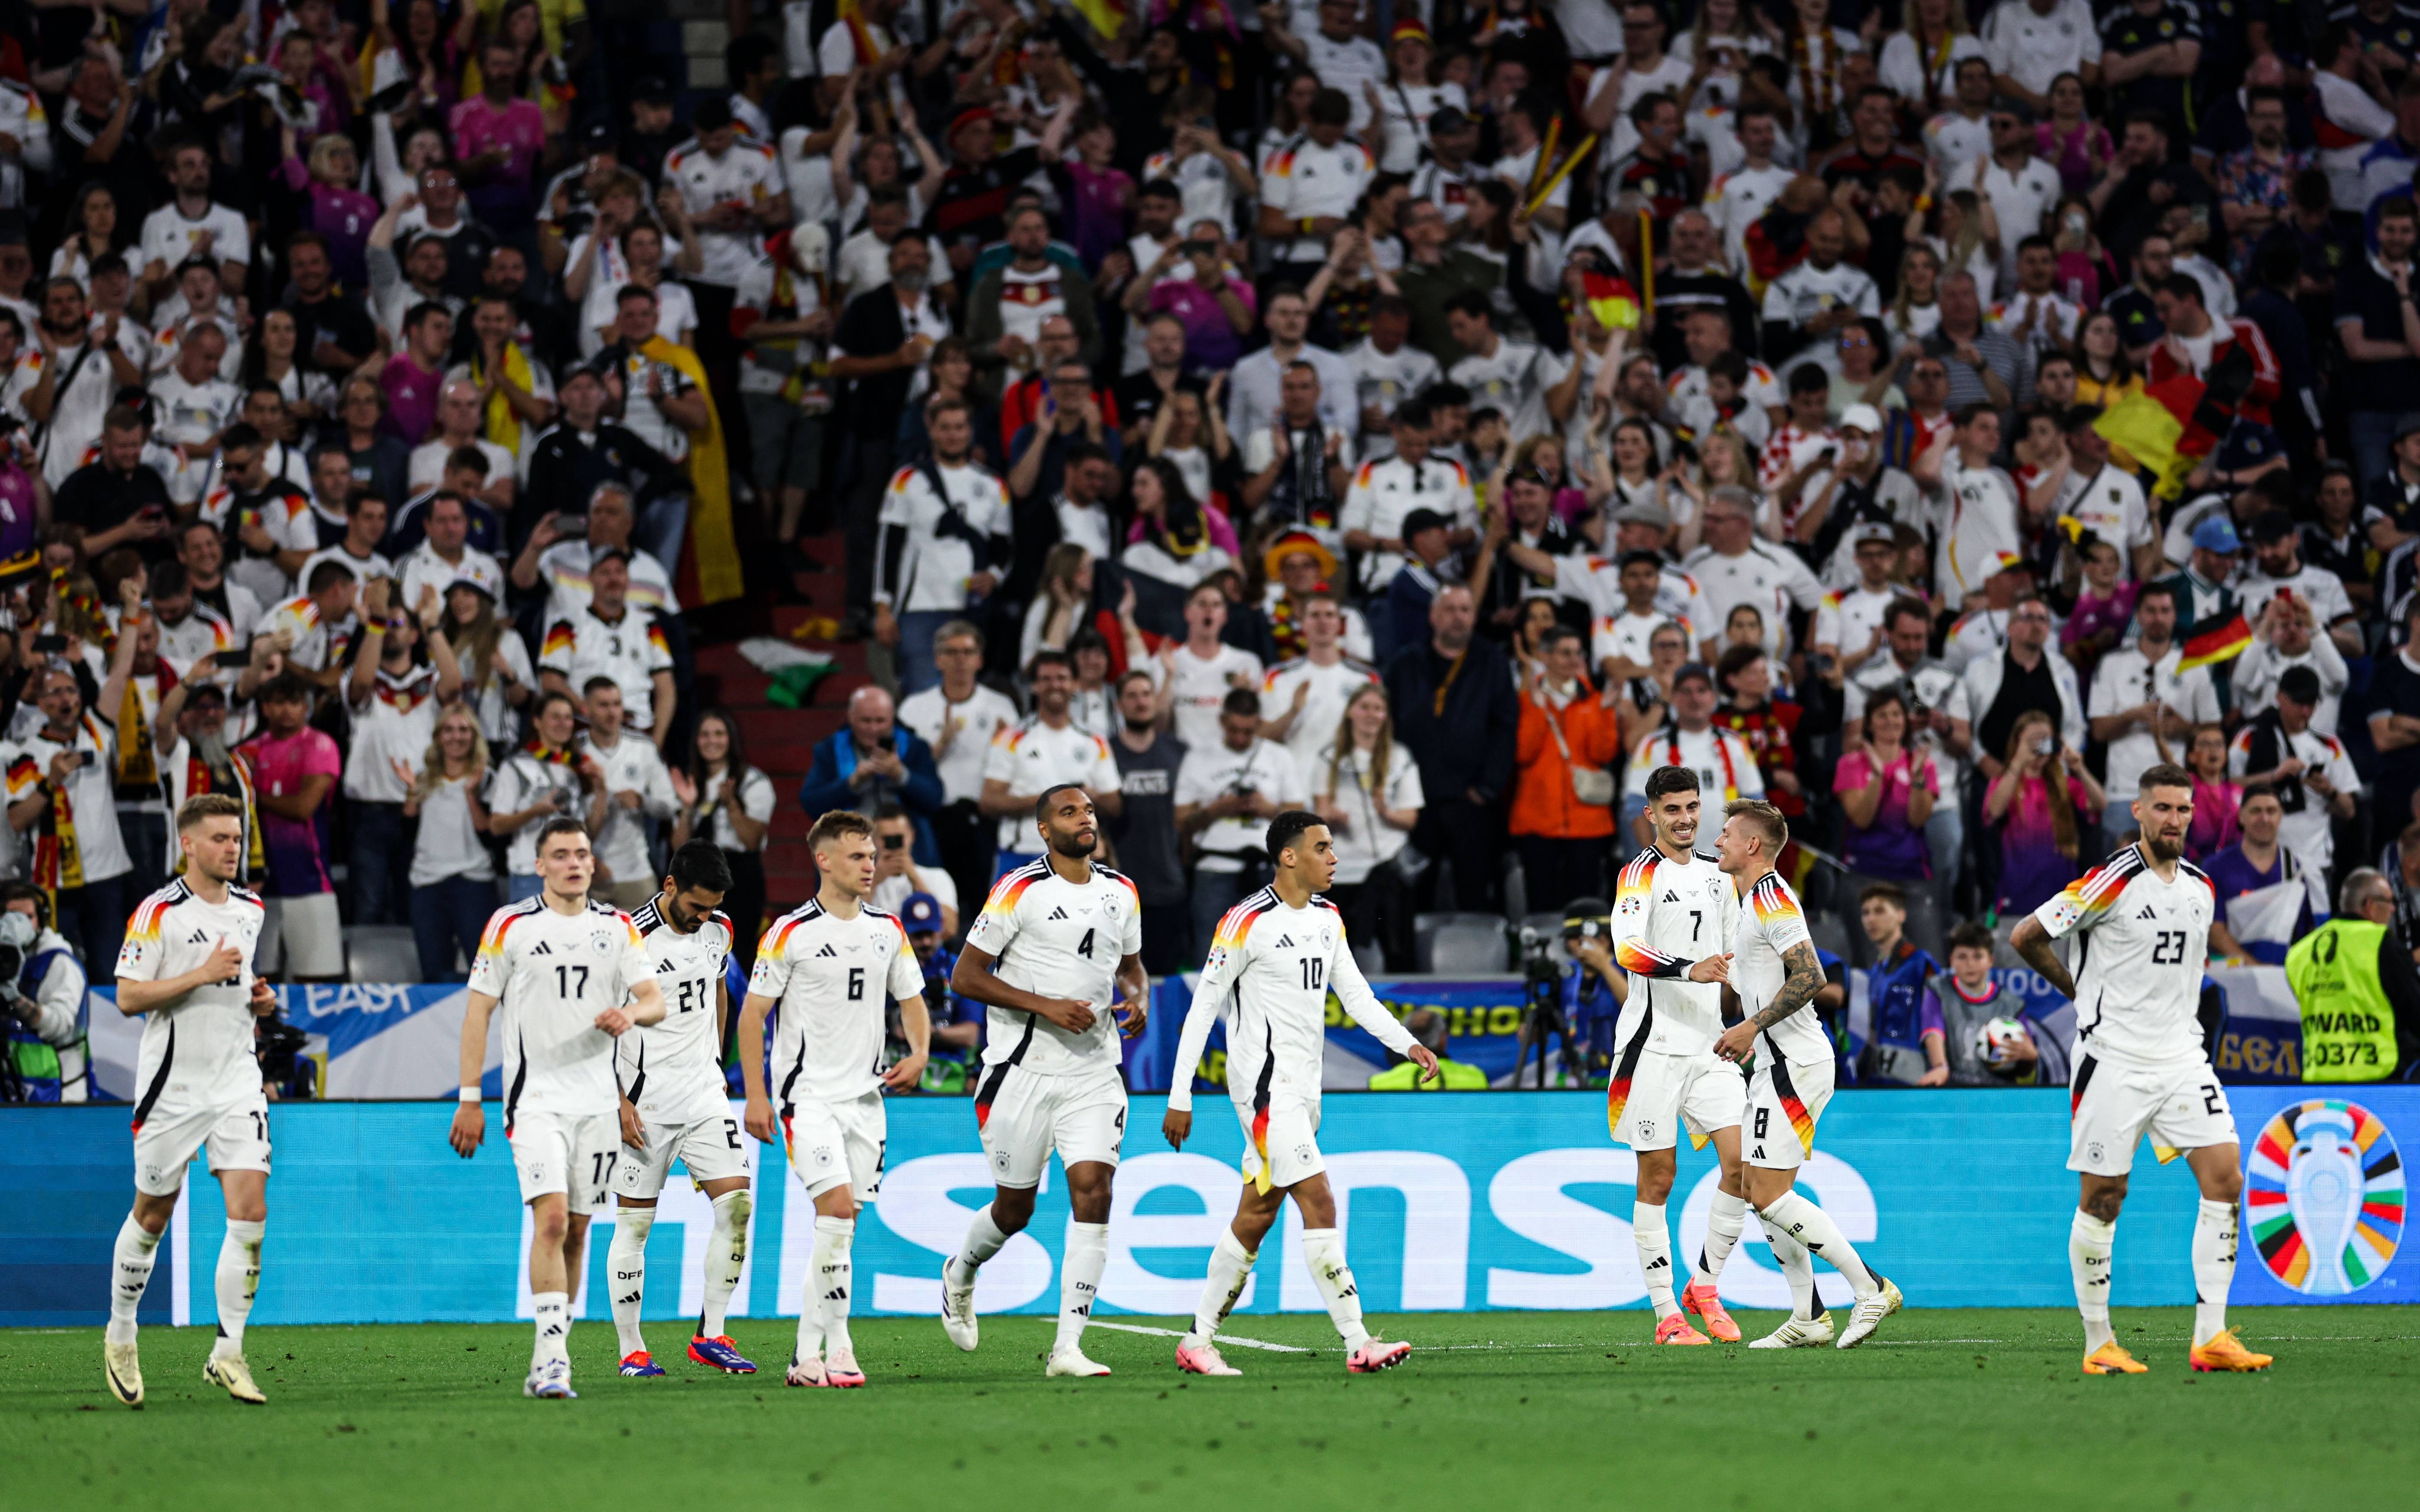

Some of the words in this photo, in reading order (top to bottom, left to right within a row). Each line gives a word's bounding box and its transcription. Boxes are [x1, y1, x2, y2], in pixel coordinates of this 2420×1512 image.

[1690, 910, 1702, 942] 7
[1078, 928, 1095, 959] 4
[2152, 931, 2187, 965] 23
[555, 965, 589, 999] 17
[848, 968, 865, 1001] 6
[1299, 958, 1323, 990] 10
[678, 978, 706, 1014] 21
[1754, 1107, 1770, 1140] 8
[592, 1151, 618, 1185] 17
[618, 1269, 643, 1280] DFB
